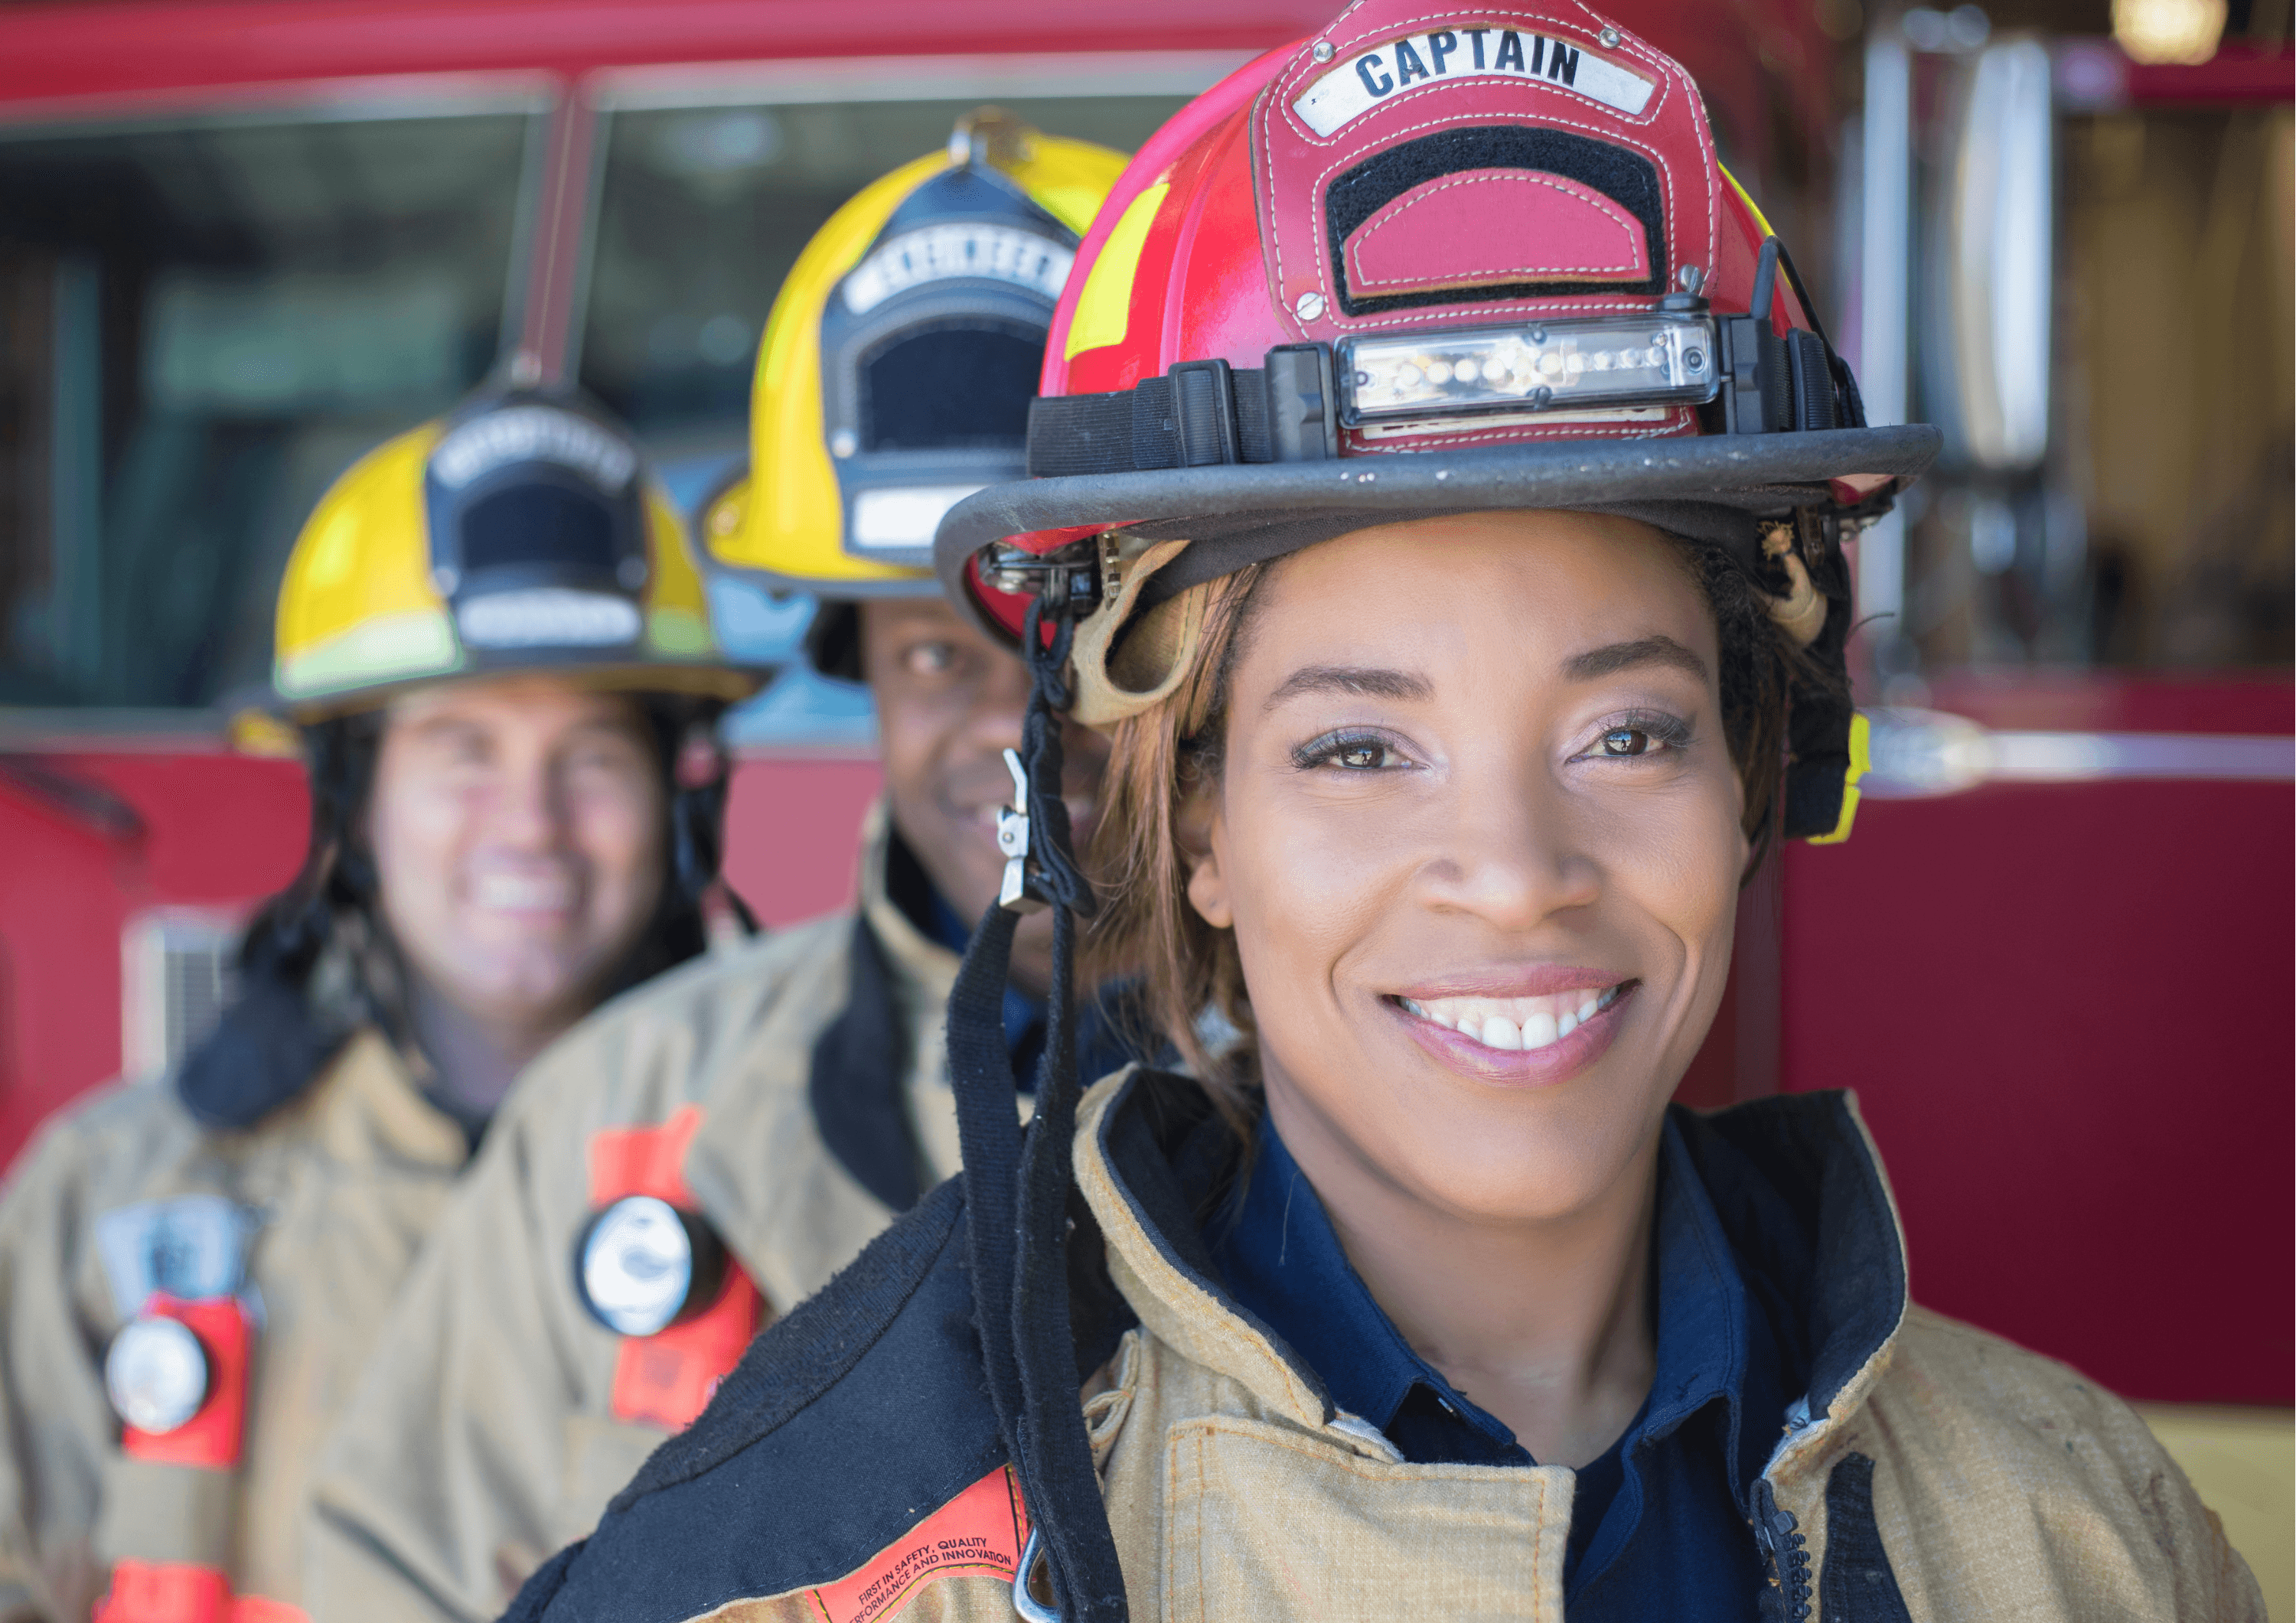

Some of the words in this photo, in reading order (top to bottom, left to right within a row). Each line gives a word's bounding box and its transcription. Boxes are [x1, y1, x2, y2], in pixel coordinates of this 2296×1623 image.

[1355, 28, 1579, 97] CAPTAIN
[850, 1569, 911, 1623] RFORMANCE
[913, 1554, 939, 1573] AND
[942, 1549, 1011, 1566] INNOVATION
[859, 1580, 881, 1605] FIRST
[882, 1571, 894, 1585] IN
[895, 1545, 935, 1574] SAFETY,
[938, 1537, 987, 1550] QUALITY
